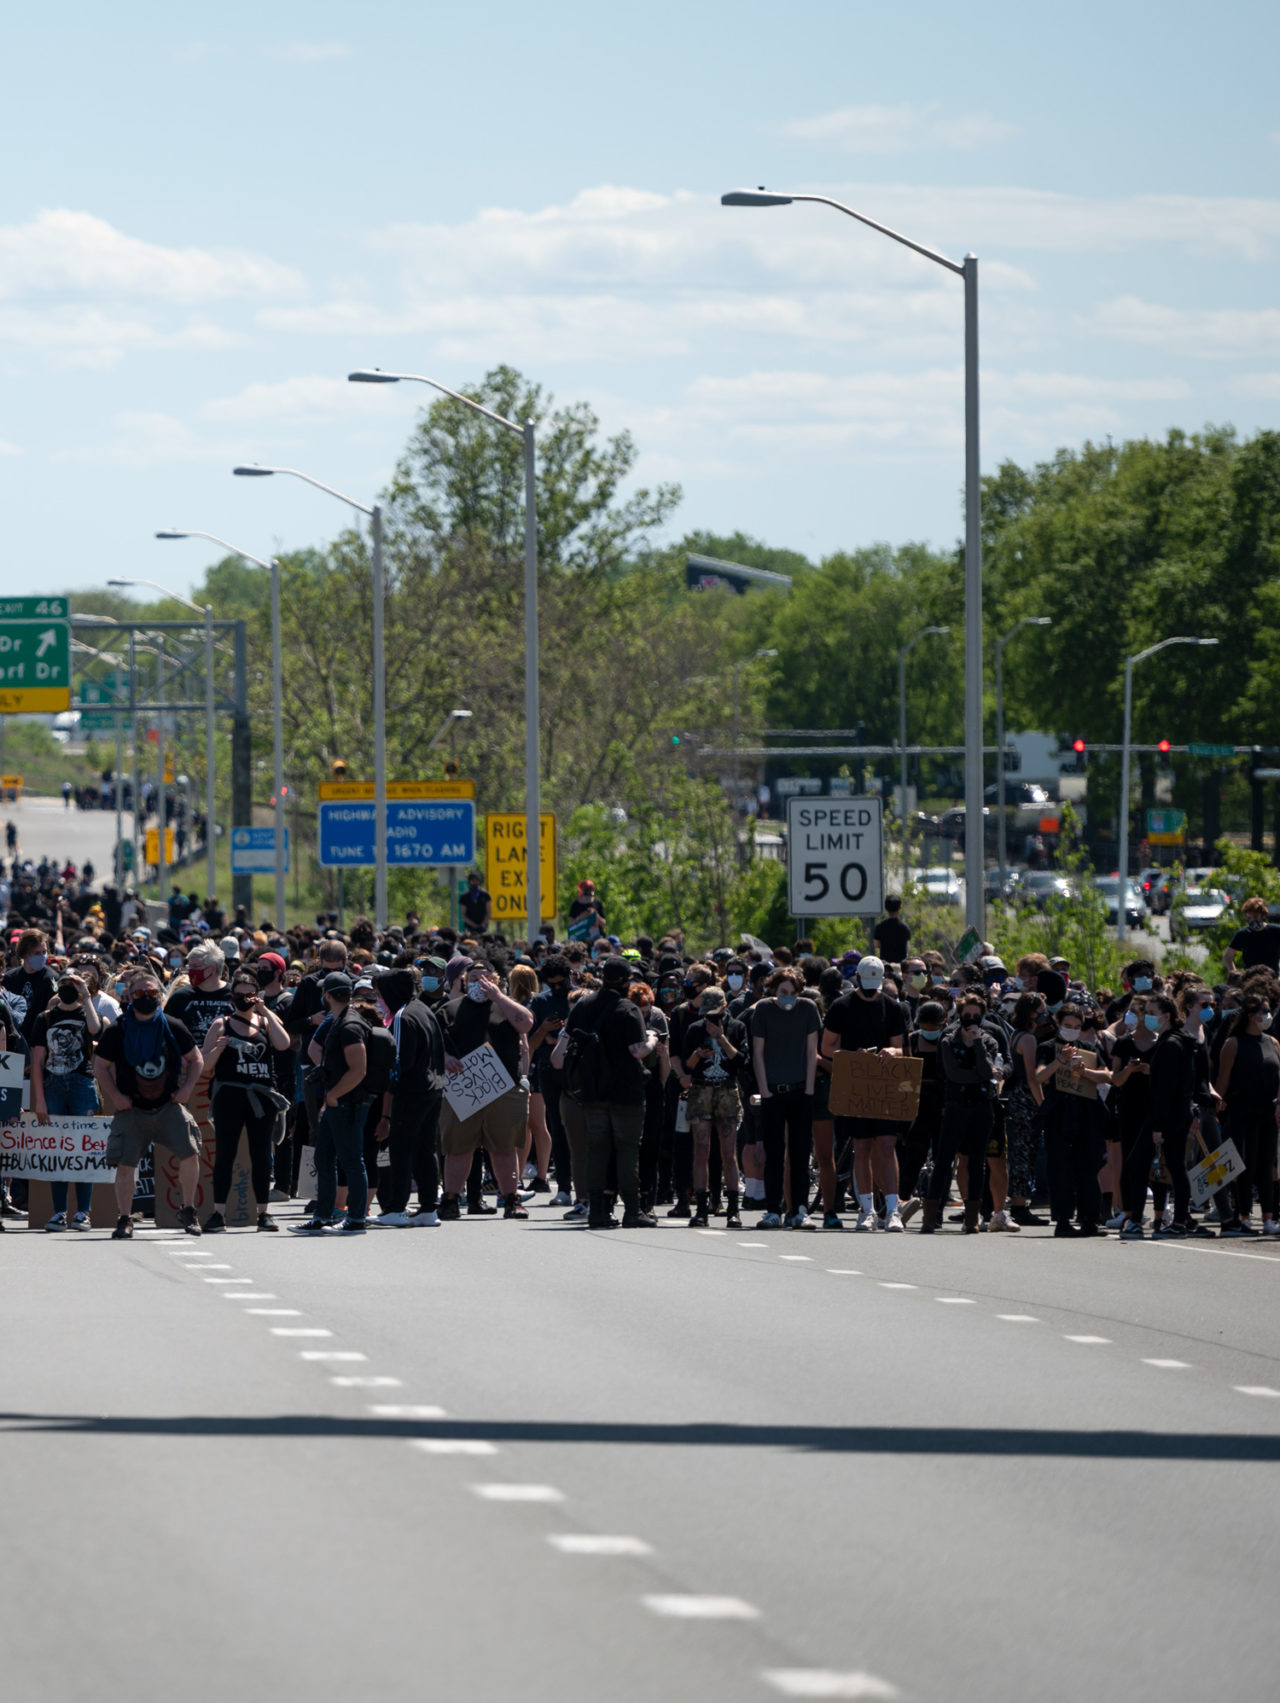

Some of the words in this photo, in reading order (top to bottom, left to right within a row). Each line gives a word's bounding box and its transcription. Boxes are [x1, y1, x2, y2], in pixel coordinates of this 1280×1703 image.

[35, 600, 63, 616] 46
[36, 663, 62, 678] Dr
[397, 808, 464, 821] ADVISORY
[799, 809, 872, 827] SPEED
[386, 826, 418, 839] ADIO
[493, 821, 548, 839] RIGT
[806, 833, 864, 850] LIMIT
[329, 846, 365, 858] TUNE
[394, 844, 433, 858] 1670
[440, 843, 466, 857] AM
[803, 861, 869, 903] 50
[236, 1063, 269, 1075] NEW
[849, 1059, 913, 1080] BLACK
[451, 1062, 496, 1097] Lives
[466, 1072, 507, 1106] Black
[851, 1083, 910, 1103] LIVES
[62, 1121, 70, 1130] a
[71, 1120, 99, 1130] time
[0, 1130, 58, 1151] Silence
[59, 1135, 76, 1152] is
[81, 1134, 107, 1152] Bet
